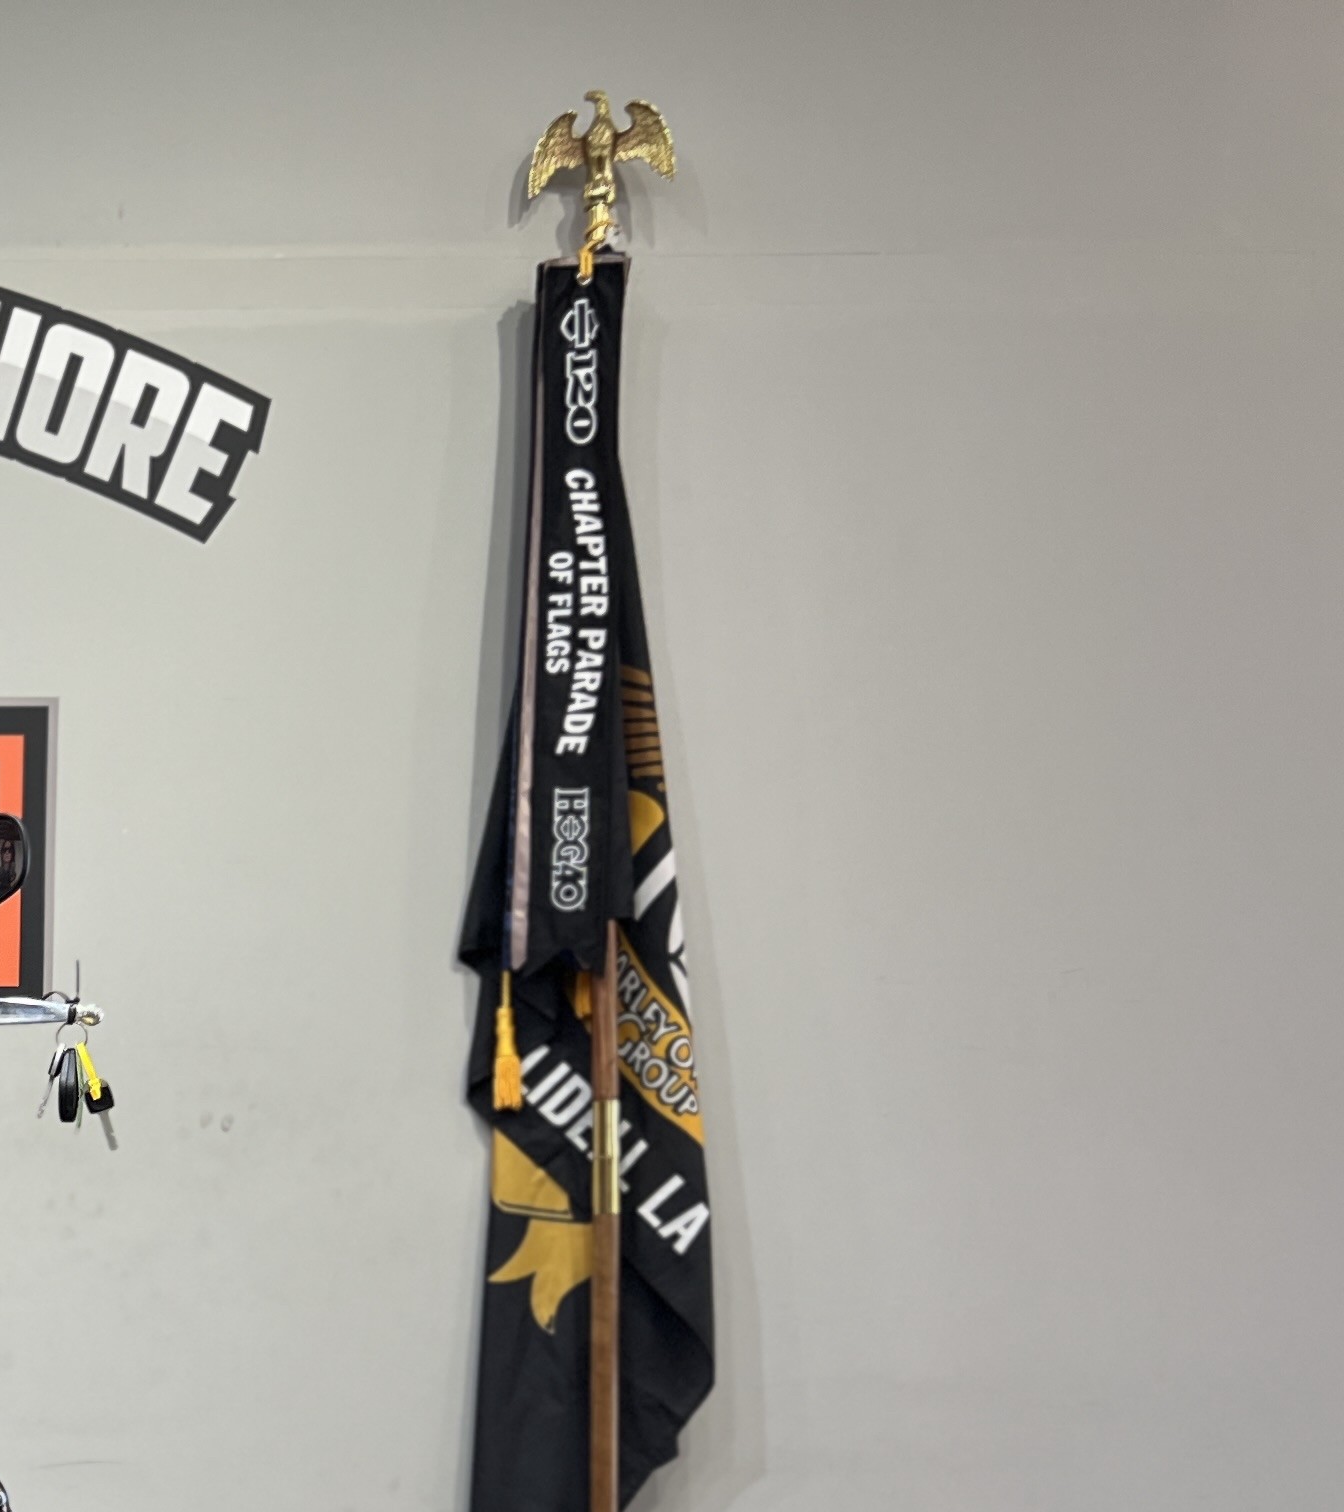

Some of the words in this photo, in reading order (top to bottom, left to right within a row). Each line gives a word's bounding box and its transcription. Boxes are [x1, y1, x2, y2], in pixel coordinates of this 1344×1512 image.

[565, 349, 597, 444] 120
[548, 551, 574, 584] OF
[565, 468, 609, 617] CHAPTER
[545, 593, 573, 675] FLAGS
[555, 628, 607, 756] PARADE
[637, 1173, 710, 1255] LA
